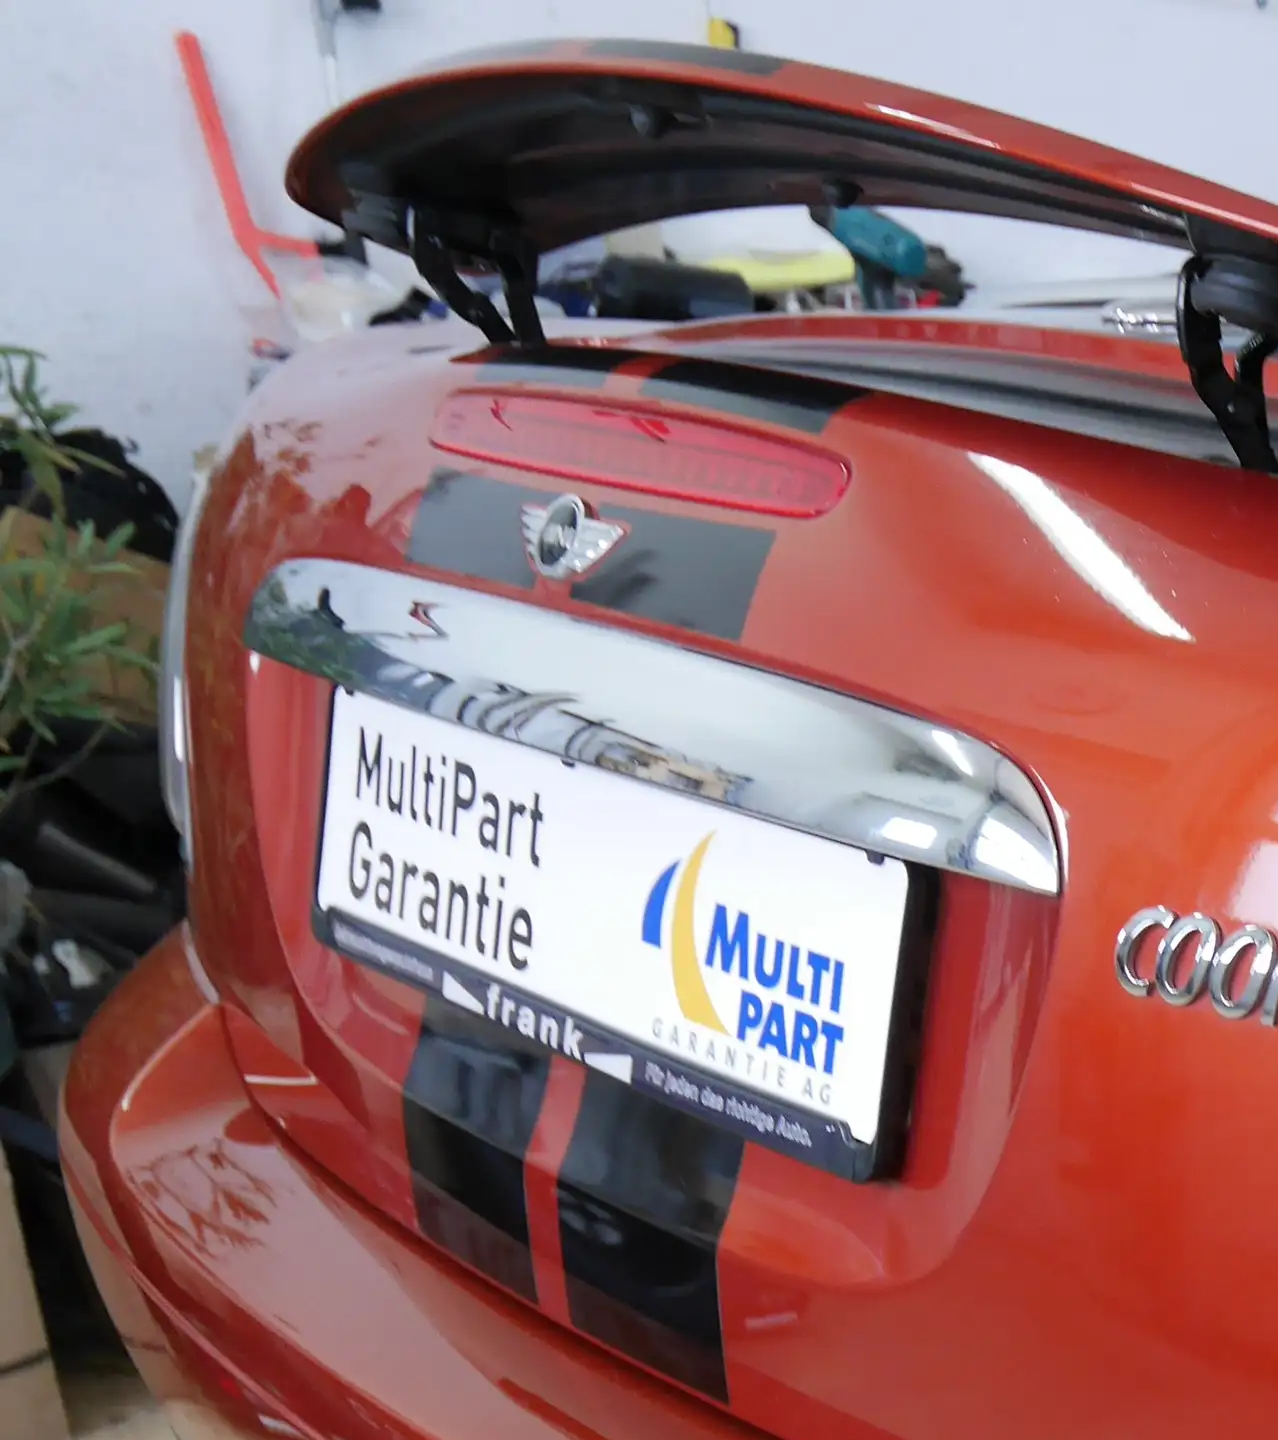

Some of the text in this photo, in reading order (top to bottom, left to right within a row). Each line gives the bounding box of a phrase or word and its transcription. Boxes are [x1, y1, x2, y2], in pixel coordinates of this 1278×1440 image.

[355, 725, 544, 868] MultiPart
[348, 820, 534, 971] Garantie
[704, 902, 844, 1013] MULTI
[486, 981, 585, 1060] frank
[651, 1017, 832, 1106] GARANTIE AG
[737, 989, 844, 1075] PART
